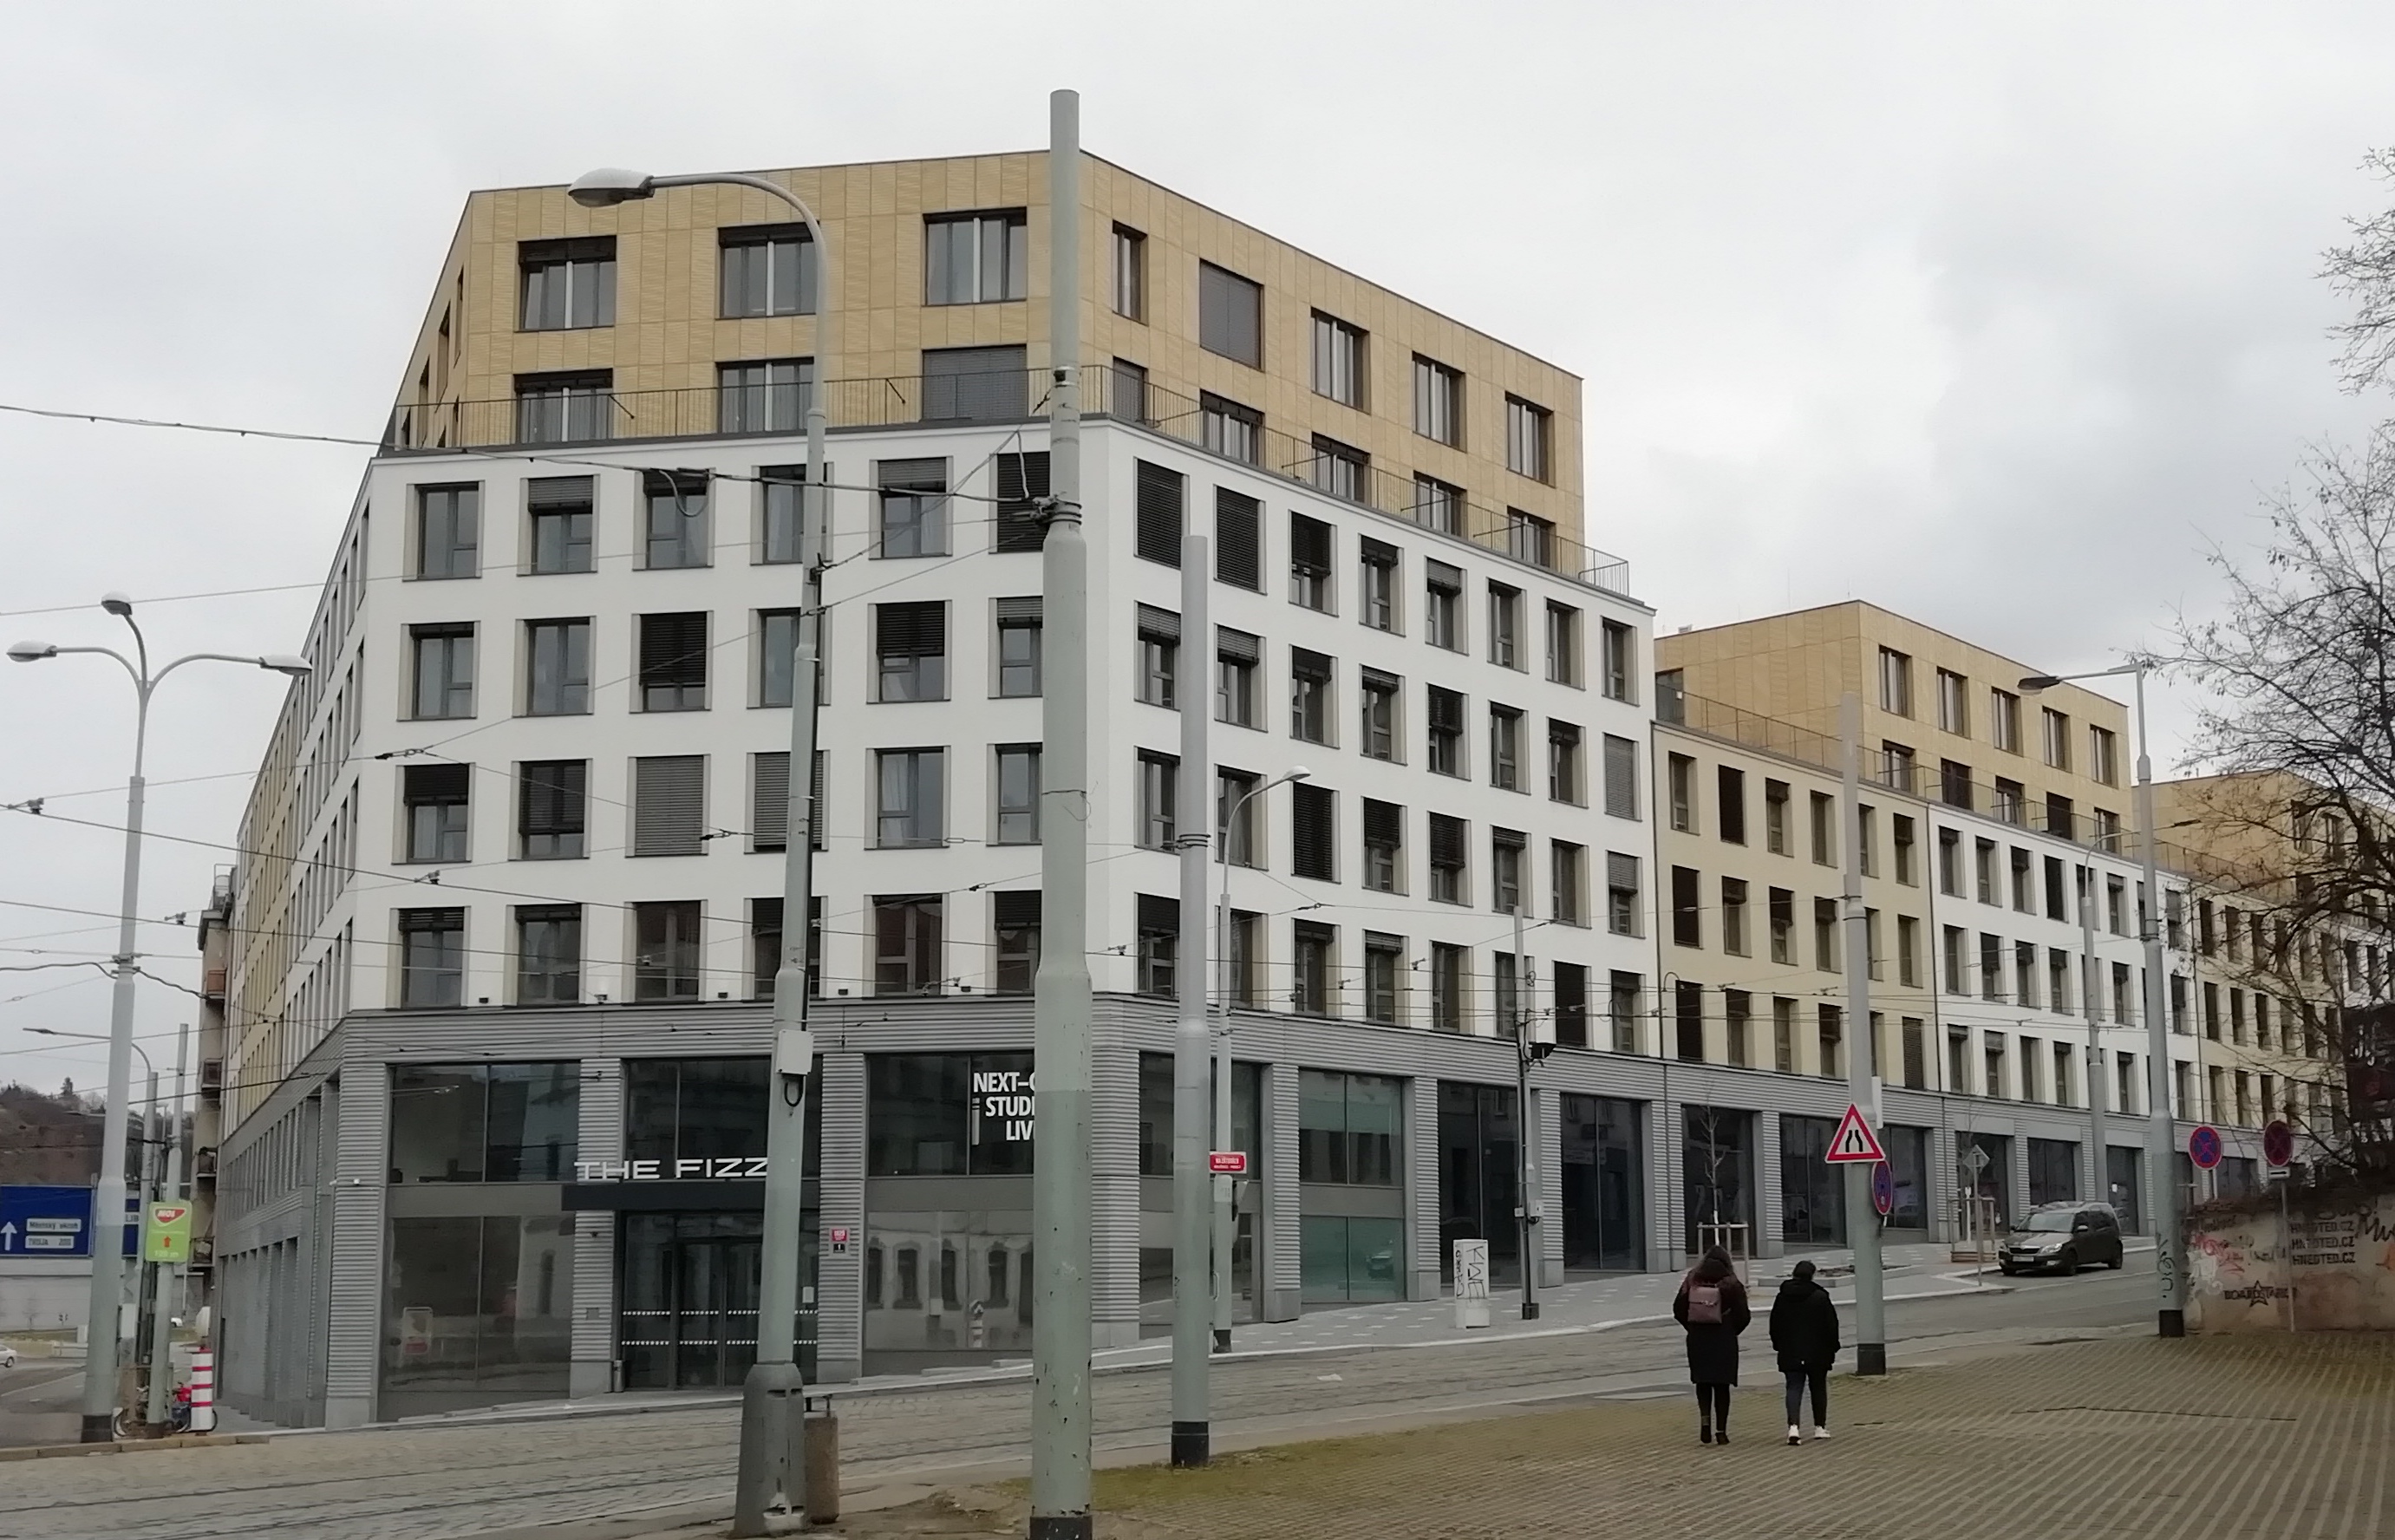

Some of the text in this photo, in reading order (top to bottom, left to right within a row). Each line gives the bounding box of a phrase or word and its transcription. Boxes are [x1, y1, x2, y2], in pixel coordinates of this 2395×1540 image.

[985, 1096, 1034, 1117] STUD
[1006, 1120, 1034, 1140] LIV
[574, 1157, 767, 1181] THE FIZZ
